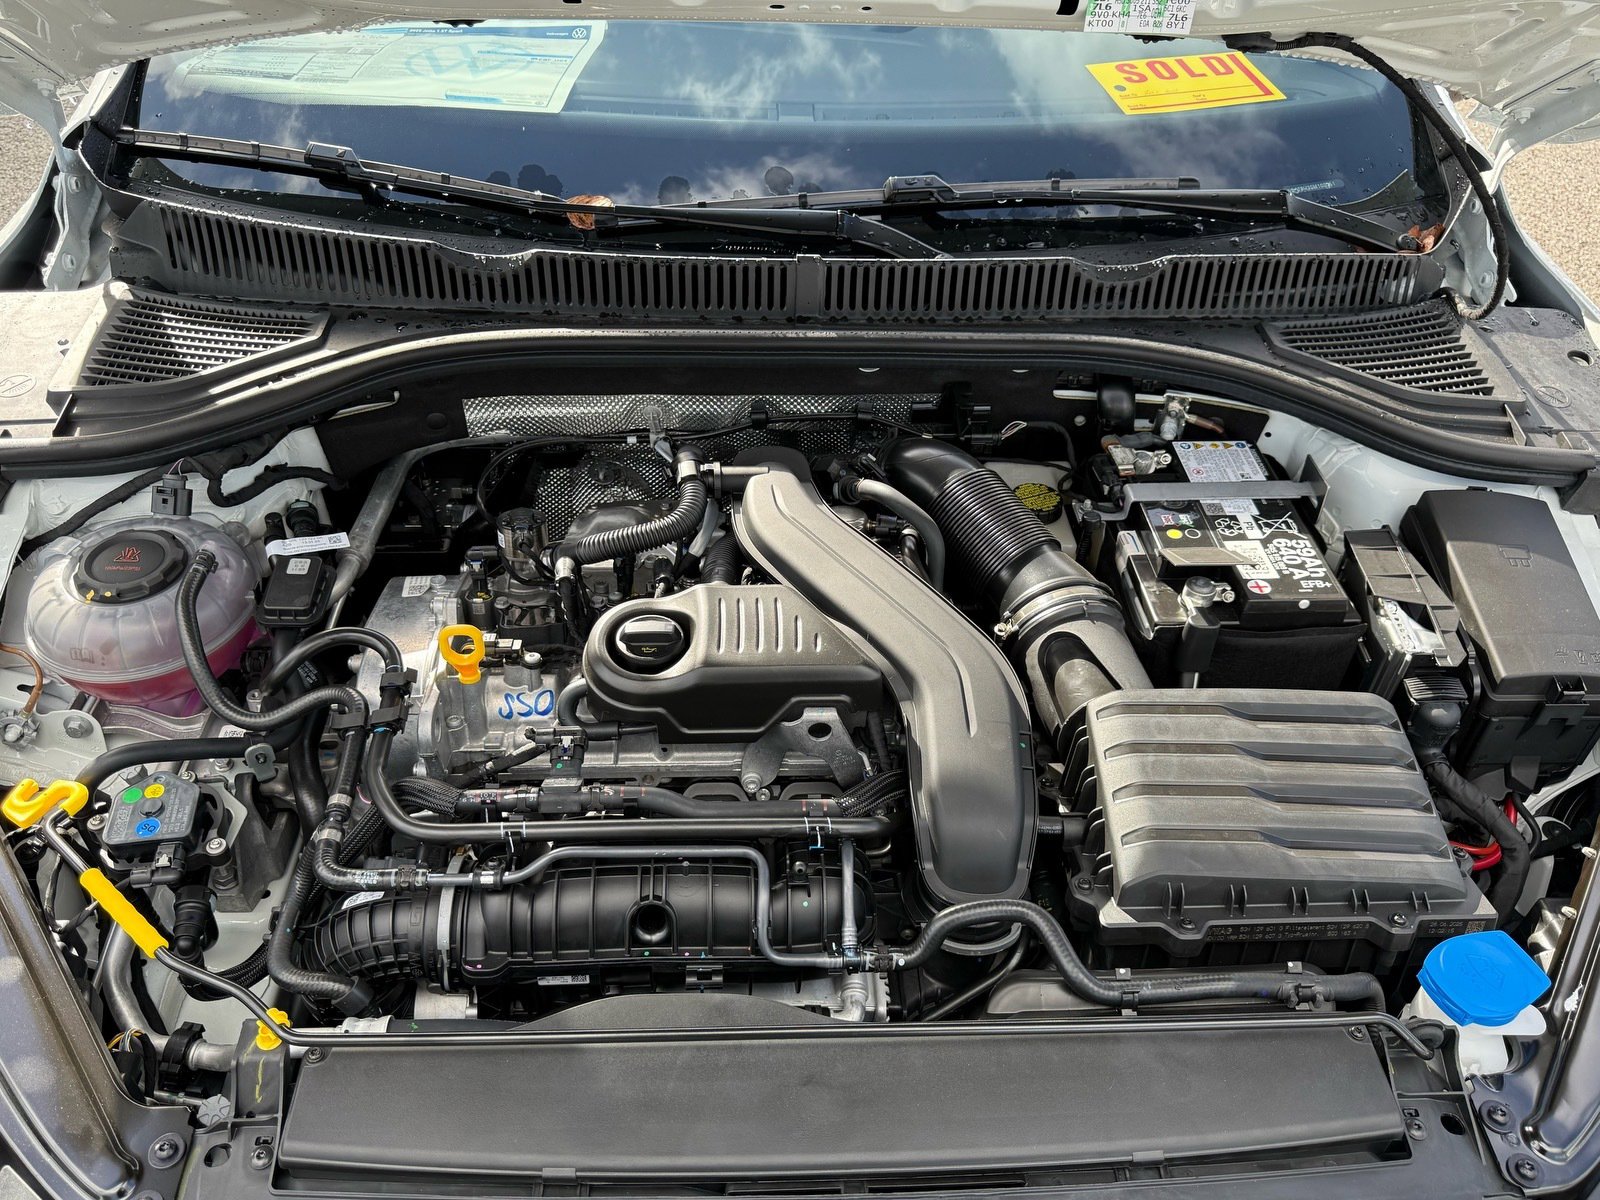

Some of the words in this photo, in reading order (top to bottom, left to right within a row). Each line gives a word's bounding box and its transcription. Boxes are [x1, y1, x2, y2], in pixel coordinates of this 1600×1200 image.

[1093, 3, 1112, 11] 7L6
[1090, 11, 1109, 19] 9V0
[1115, 55, 1235, 83] SOLD
[1272, 538, 1303, 565] 640
[1288, 567, 1310, 580] A
[1291, 540, 1327, 578] 59Ah
[1300, 580, 1332, 588] EFB+
[141, 823, 156, 833] SQ
